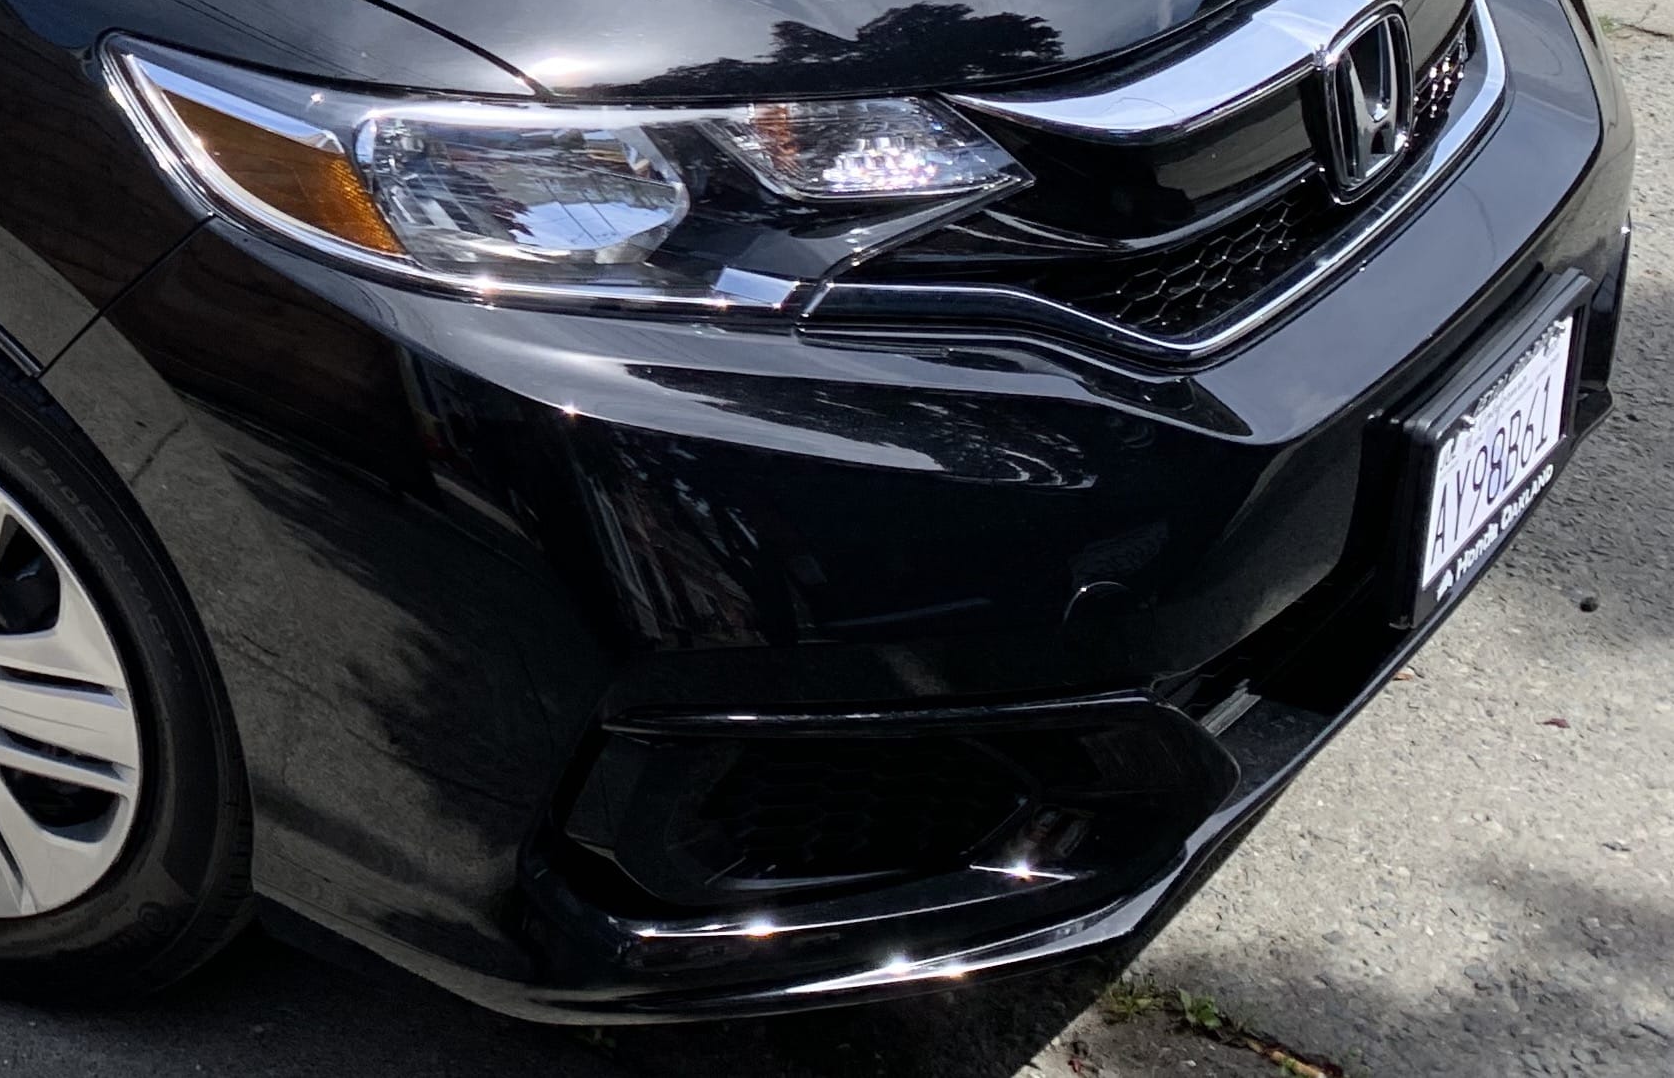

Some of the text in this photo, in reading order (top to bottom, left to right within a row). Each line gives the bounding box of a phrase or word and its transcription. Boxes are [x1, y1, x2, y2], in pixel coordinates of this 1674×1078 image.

[1431, 375, 1552, 564] AY98B61
[1456, 522, 1499, 581] Honda
[1500, 463, 1554, 530] OAKLAND
